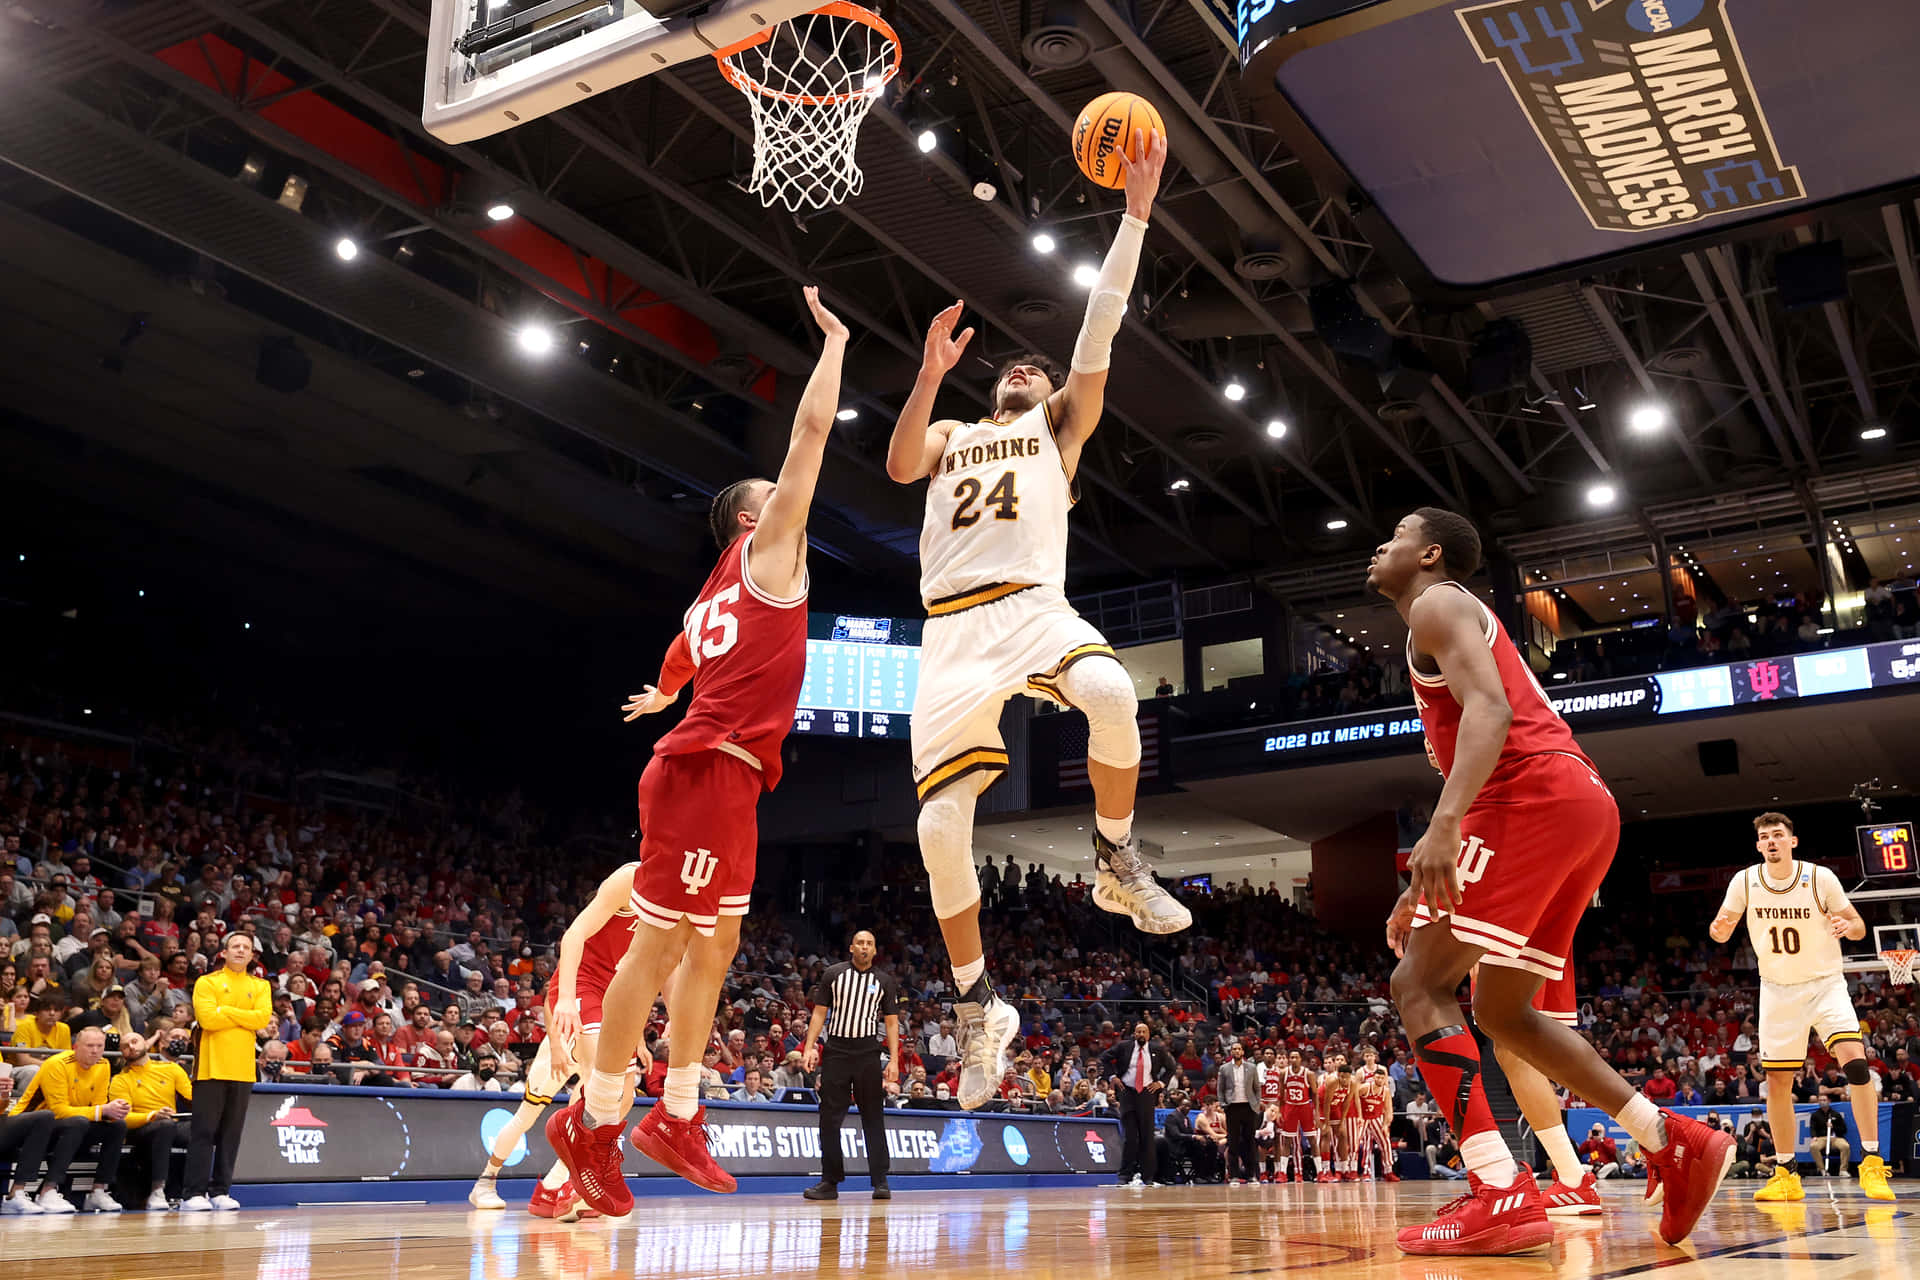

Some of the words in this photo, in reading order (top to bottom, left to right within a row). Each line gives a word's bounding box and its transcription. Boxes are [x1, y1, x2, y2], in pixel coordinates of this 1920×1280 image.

[1629, 28, 1757, 165] MARCH
[1095, 117, 1123, 177] Wilson
[1554, 71, 1699, 226] MADNESS
[945, 437, 1040, 474] WYOMING
[951, 470, 1019, 532] 24
[1265, 733, 1307, 751] 2022
[1311, 730, 1331, 746] DI
[1334, 723, 1385, 743] MEN'S
[1882, 843, 1907, 870] 18
[1755, 907, 1810, 919] WYOMING
[1768, 926, 1801, 955] 10
[1265, 1082, 1279, 1095] 22
[1289, 1088, 1303, 1101] 53
[276, 1125, 326, 1147] Pizza
[281, 1143, 321, 1163] Hut
